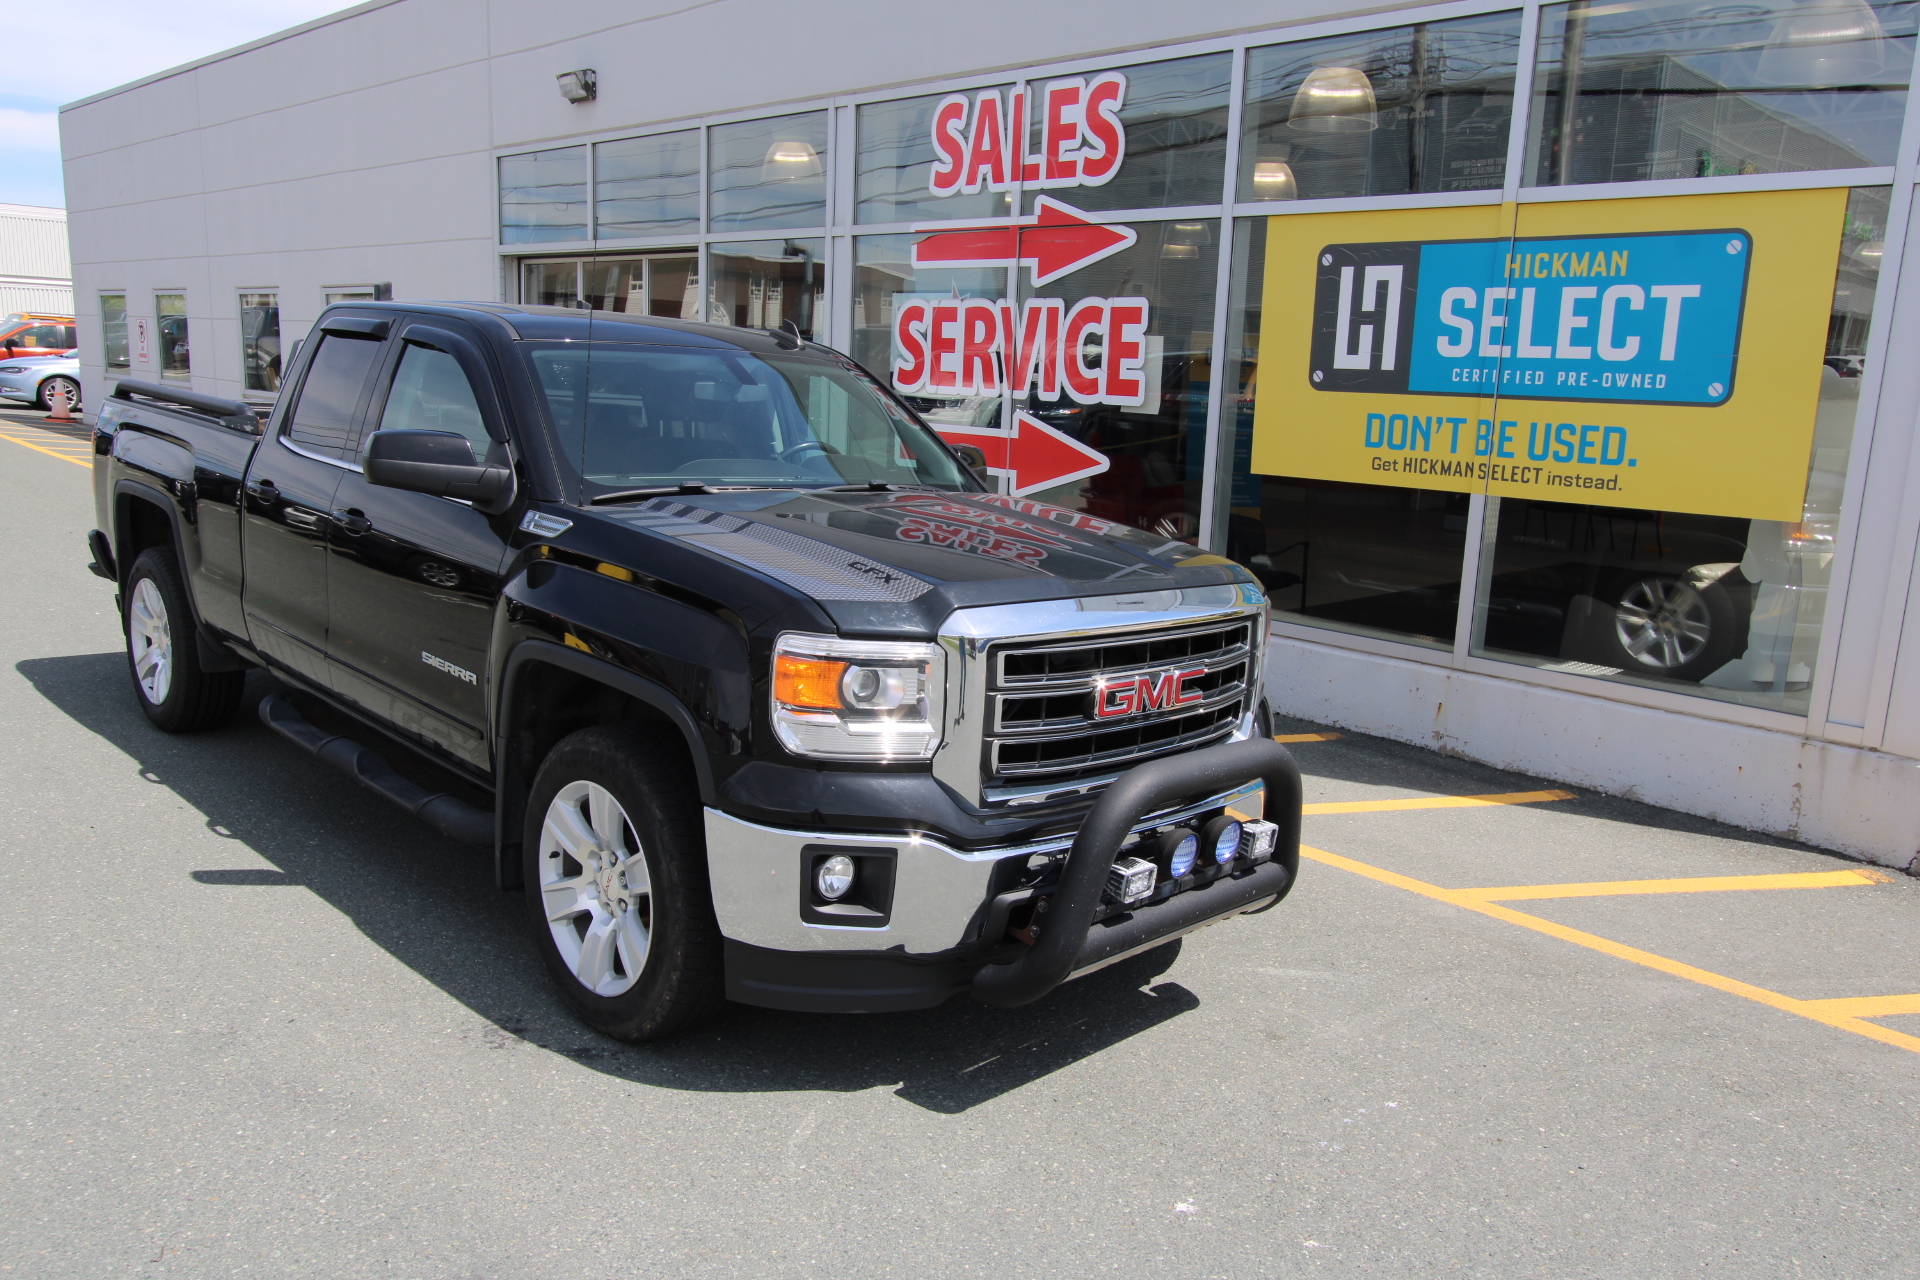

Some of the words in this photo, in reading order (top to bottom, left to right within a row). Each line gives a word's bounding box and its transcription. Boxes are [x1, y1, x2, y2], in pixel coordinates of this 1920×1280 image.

[931, 76, 1123, 193] SALES
[1504, 250, 1629, 279] HICKMAN
[1436, 284, 1702, 362] SELECT
[894, 300, 1146, 402] SERVICE
[1452, 368, 1544, 385] CERTIFIED
[1556, 370, 1667, 389] PRE-OWNED
[1364, 413, 1468, 454] DON'T
[1474, 419, 1518, 459] BE
[1527, 422, 1638, 467] USED.
[1371, 456, 1399, 472] Get
[1402, 457, 1475, 478] HICKMAN
[1477, 462, 1544, 485] SELECT
[1546, 471, 1623, 491] instead.
[421, 650, 478, 686] SIERRA
[1096, 667, 1207, 718] GMC
